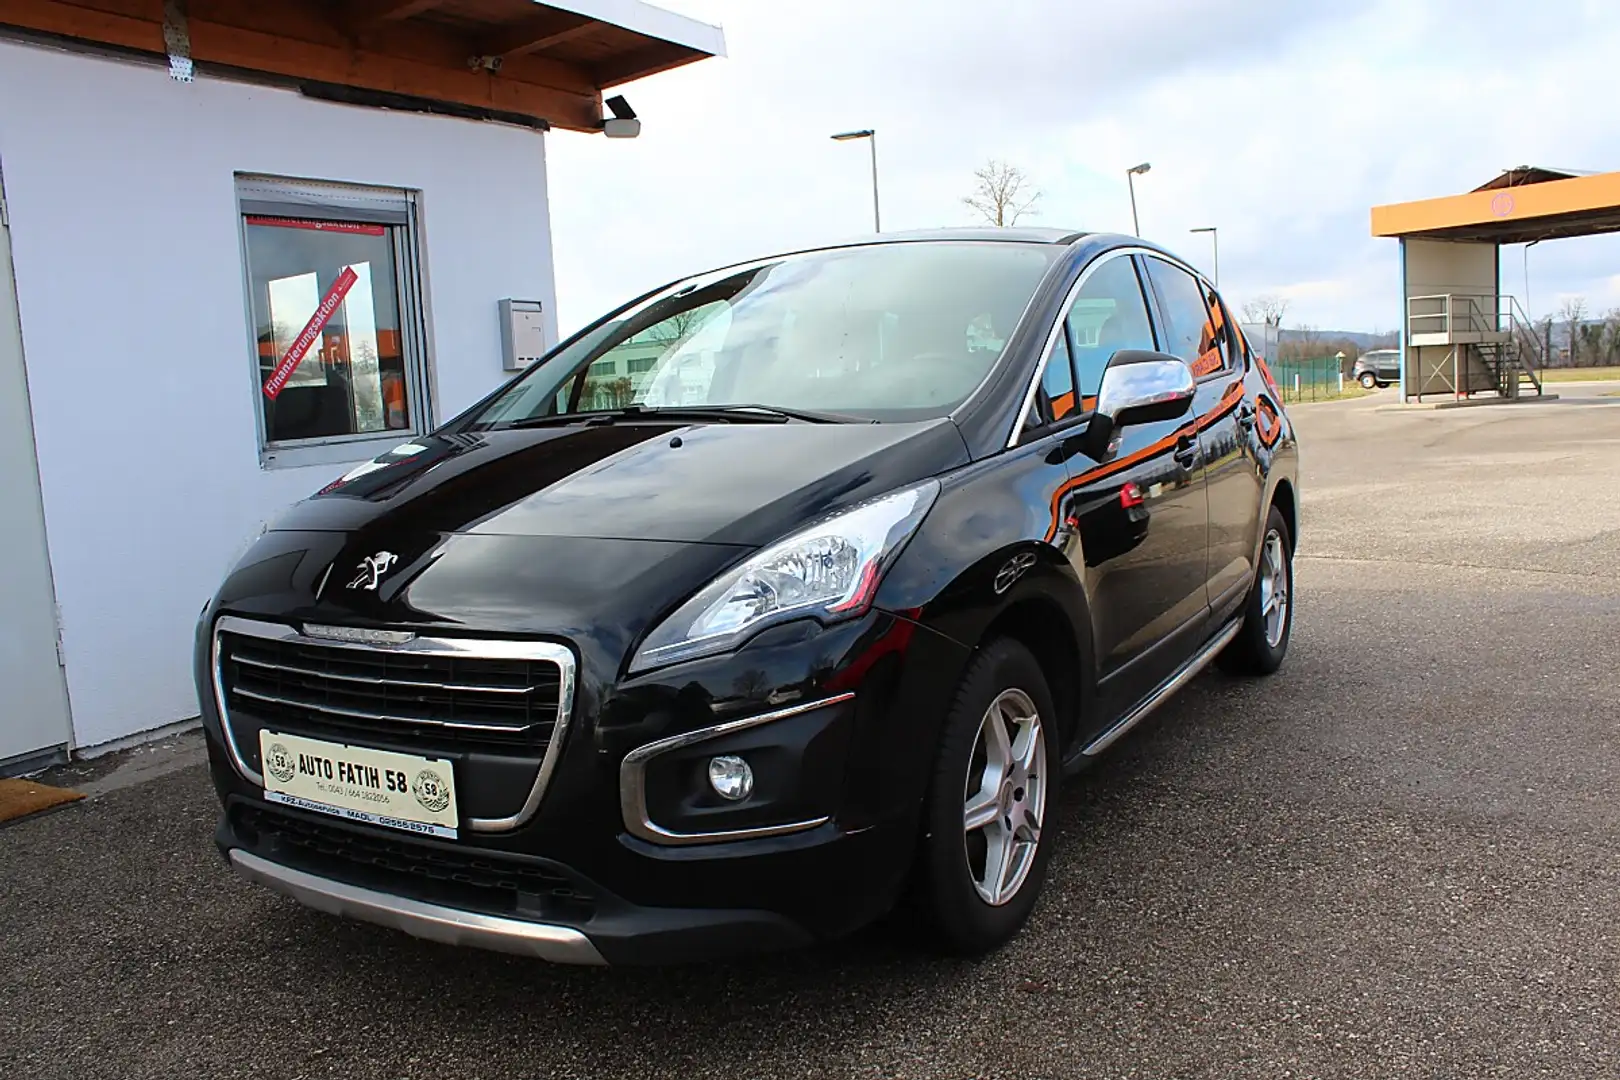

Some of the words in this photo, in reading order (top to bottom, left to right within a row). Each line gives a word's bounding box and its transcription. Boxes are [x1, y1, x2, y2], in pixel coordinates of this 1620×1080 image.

[266, 292, 339, 395] Finanzierungsaktion
[275, 754, 286, 768] 58
[299, 753, 333, 780] AUTO
[338, 761, 380, 789] FATIH
[385, 770, 408, 793] 58
[424, 783, 438, 797] 58
